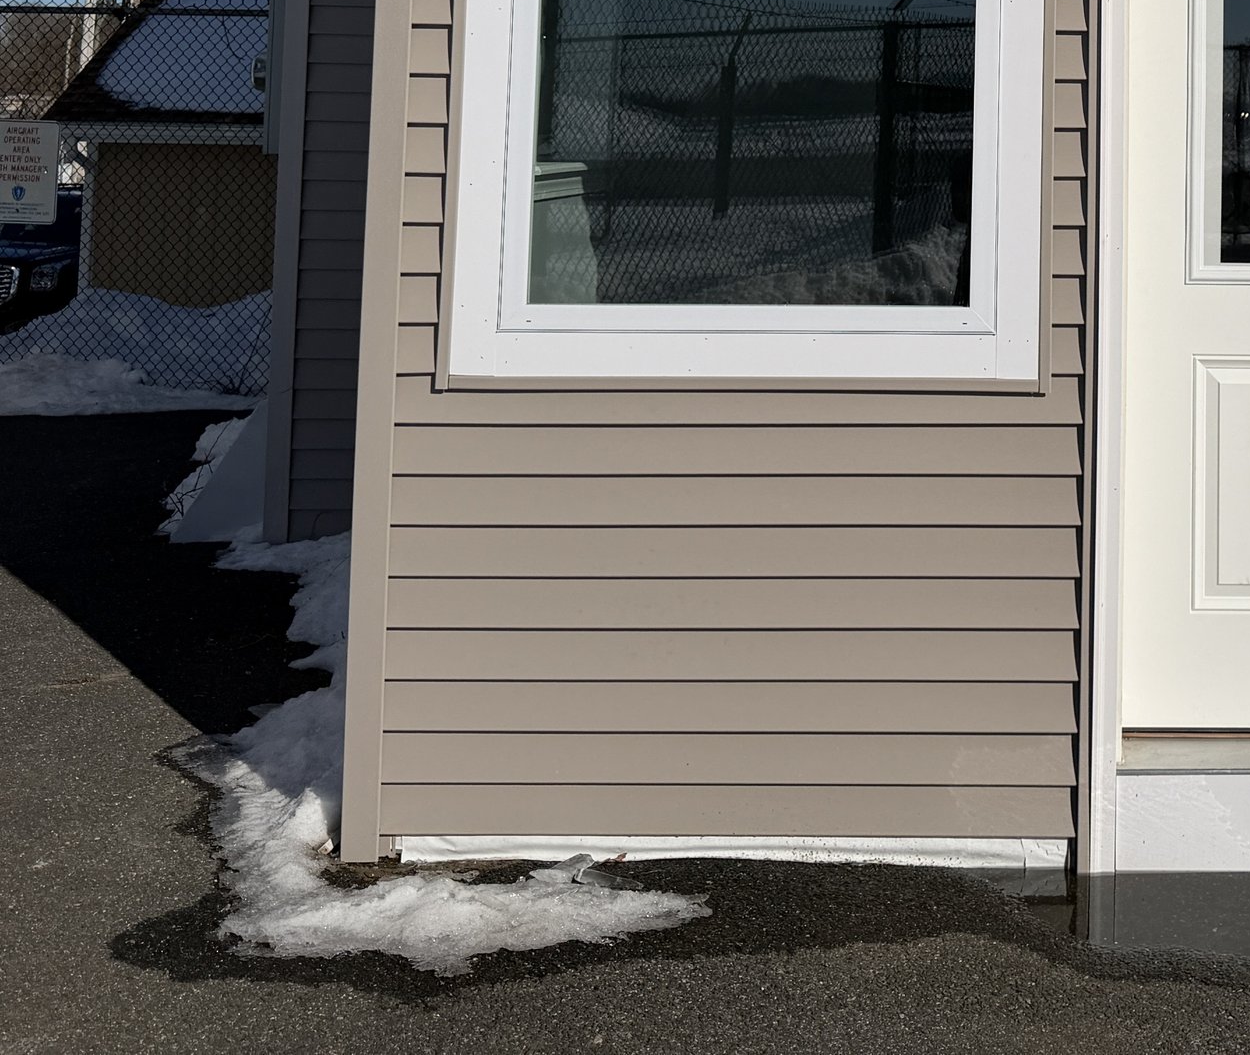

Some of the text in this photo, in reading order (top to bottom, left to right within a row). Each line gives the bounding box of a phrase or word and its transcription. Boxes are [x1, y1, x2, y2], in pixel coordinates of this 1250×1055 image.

[6, 127, 40, 135] AIRCRAFT
[4, 136, 40, 145] OPERATING
[25, 155, 42, 163] ONLY
[11, 165, 48, 173] MANAGER'S
